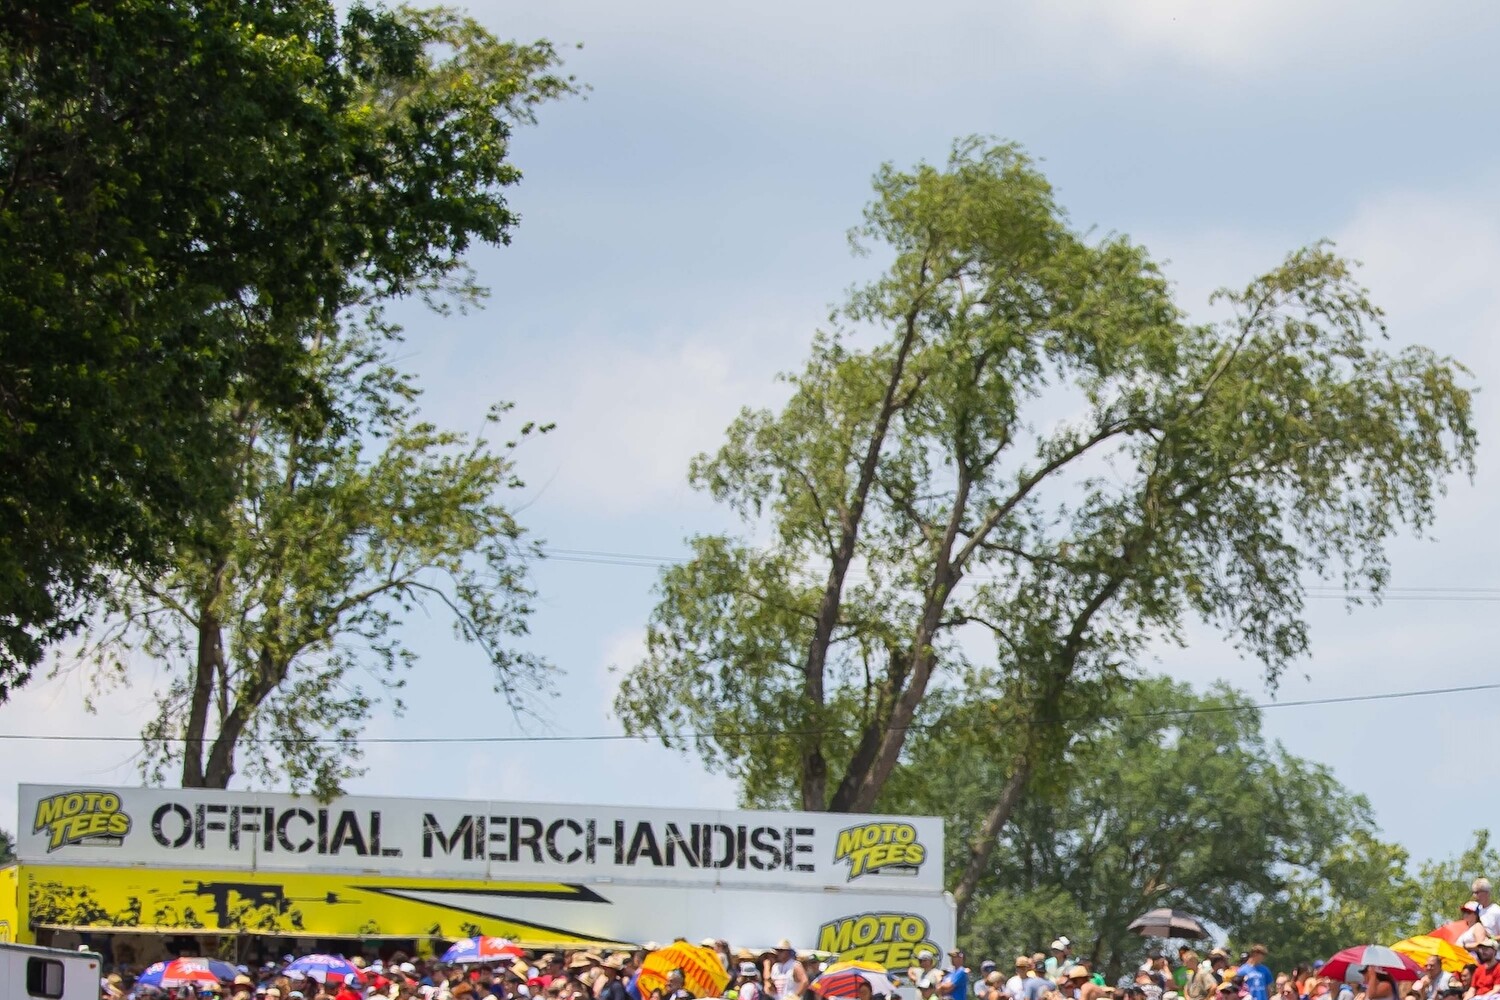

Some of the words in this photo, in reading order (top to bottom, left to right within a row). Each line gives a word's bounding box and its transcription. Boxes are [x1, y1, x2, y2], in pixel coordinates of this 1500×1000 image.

[35, 792, 120, 832] MOTO
[49, 812, 130, 850] TEES
[151, 803, 402, 857] OFFICIAL
[423, 813, 815, 871] MERCHANDISE
[836, 823, 916, 857] MOTO
[849, 842, 926, 881] TEES
[820, 915, 924, 952] MOTO
